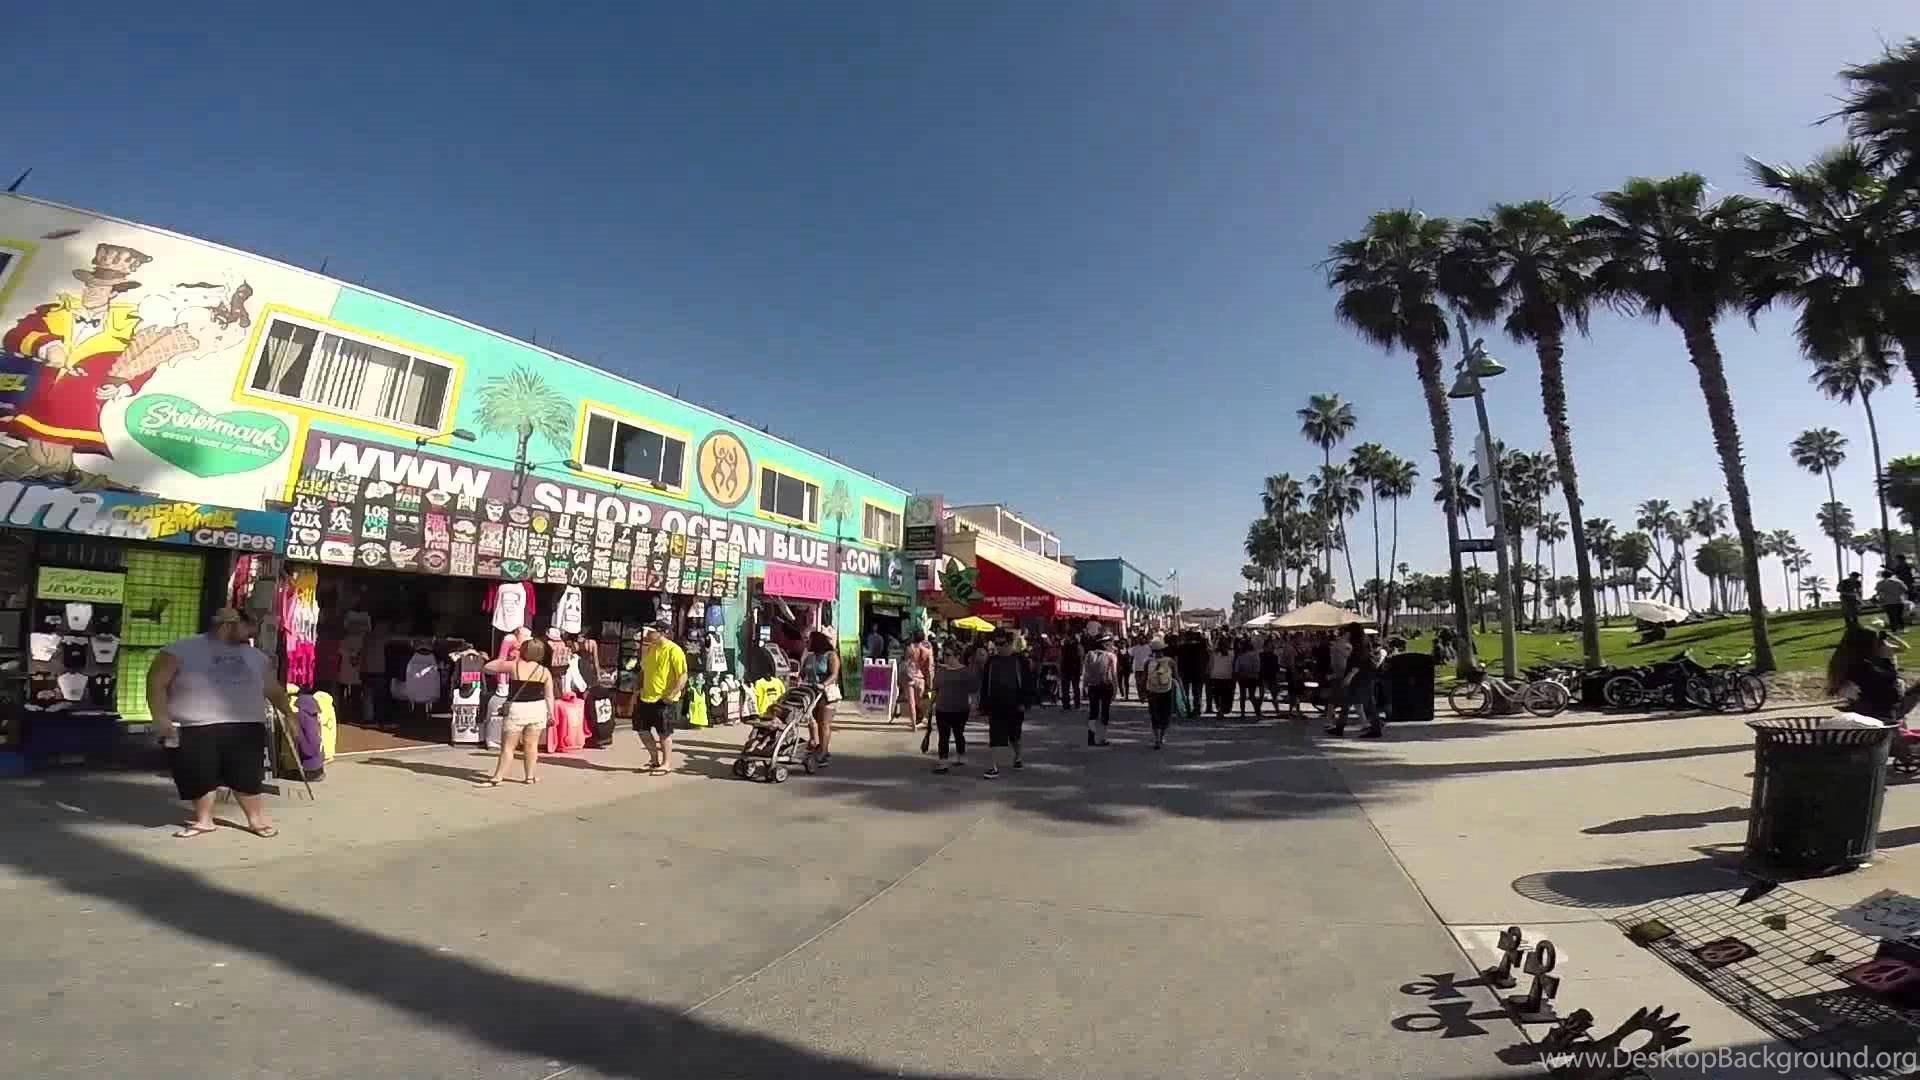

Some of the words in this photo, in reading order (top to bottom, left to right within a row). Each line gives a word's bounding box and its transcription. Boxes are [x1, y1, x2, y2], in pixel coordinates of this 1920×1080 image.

[141, 401, 284, 452] Steiermark
[316, 438, 492, 498] WWW
[532, 482, 652, 527] SHOP
[661, 510, 767, 556] OCEAN
[773, 533, 829, 567] BLUE
[841, 548, 881, 576] .COM
[364, 504, 389, 519] LOS
[47, 583, 120, 597] JEWELRY
[863, 693, 889, 704] ATM
